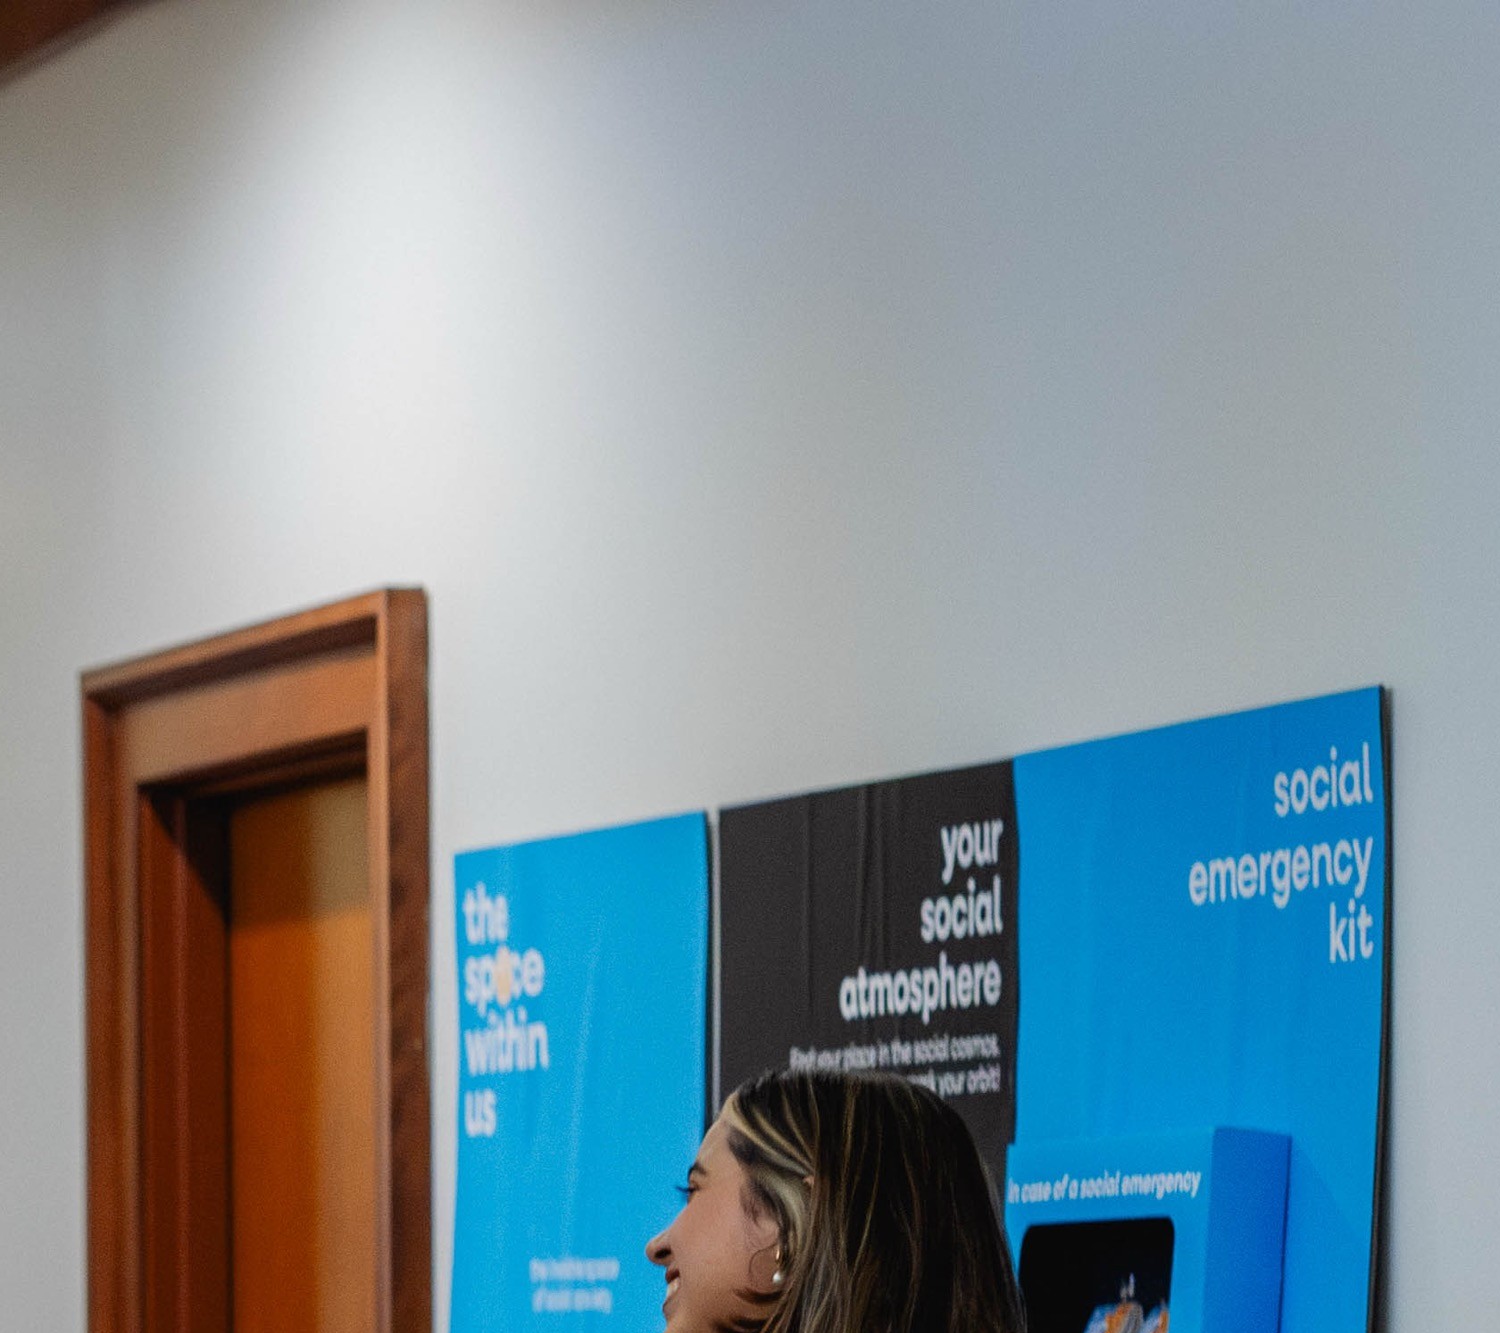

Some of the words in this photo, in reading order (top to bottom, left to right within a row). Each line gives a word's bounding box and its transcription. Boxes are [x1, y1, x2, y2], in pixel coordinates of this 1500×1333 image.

[1274, 741, 1373, 818] social
[940, 818, 1003, 884] your
[1189, 836, 1373, 909] emergency
[463, 881, 508, 945] the
[921, 873, 1003, 943] social
[1330, 898, 1373, 963] kit
[464, 945, 545, 1018] spce
[839, 951, 1002, 1025] atmosphere
[464, 1005, 550, 1077] within
[464, 1088, 497, 1138] us
[1022, 1181, 1051, 1203] case
[1053, 1173, 1069, 1200] of
[1069, 1179, 1078, 1200] a
[1080, 1170, 1120, 1199] social
[1122, 1171, 1200, 1200] emergency
